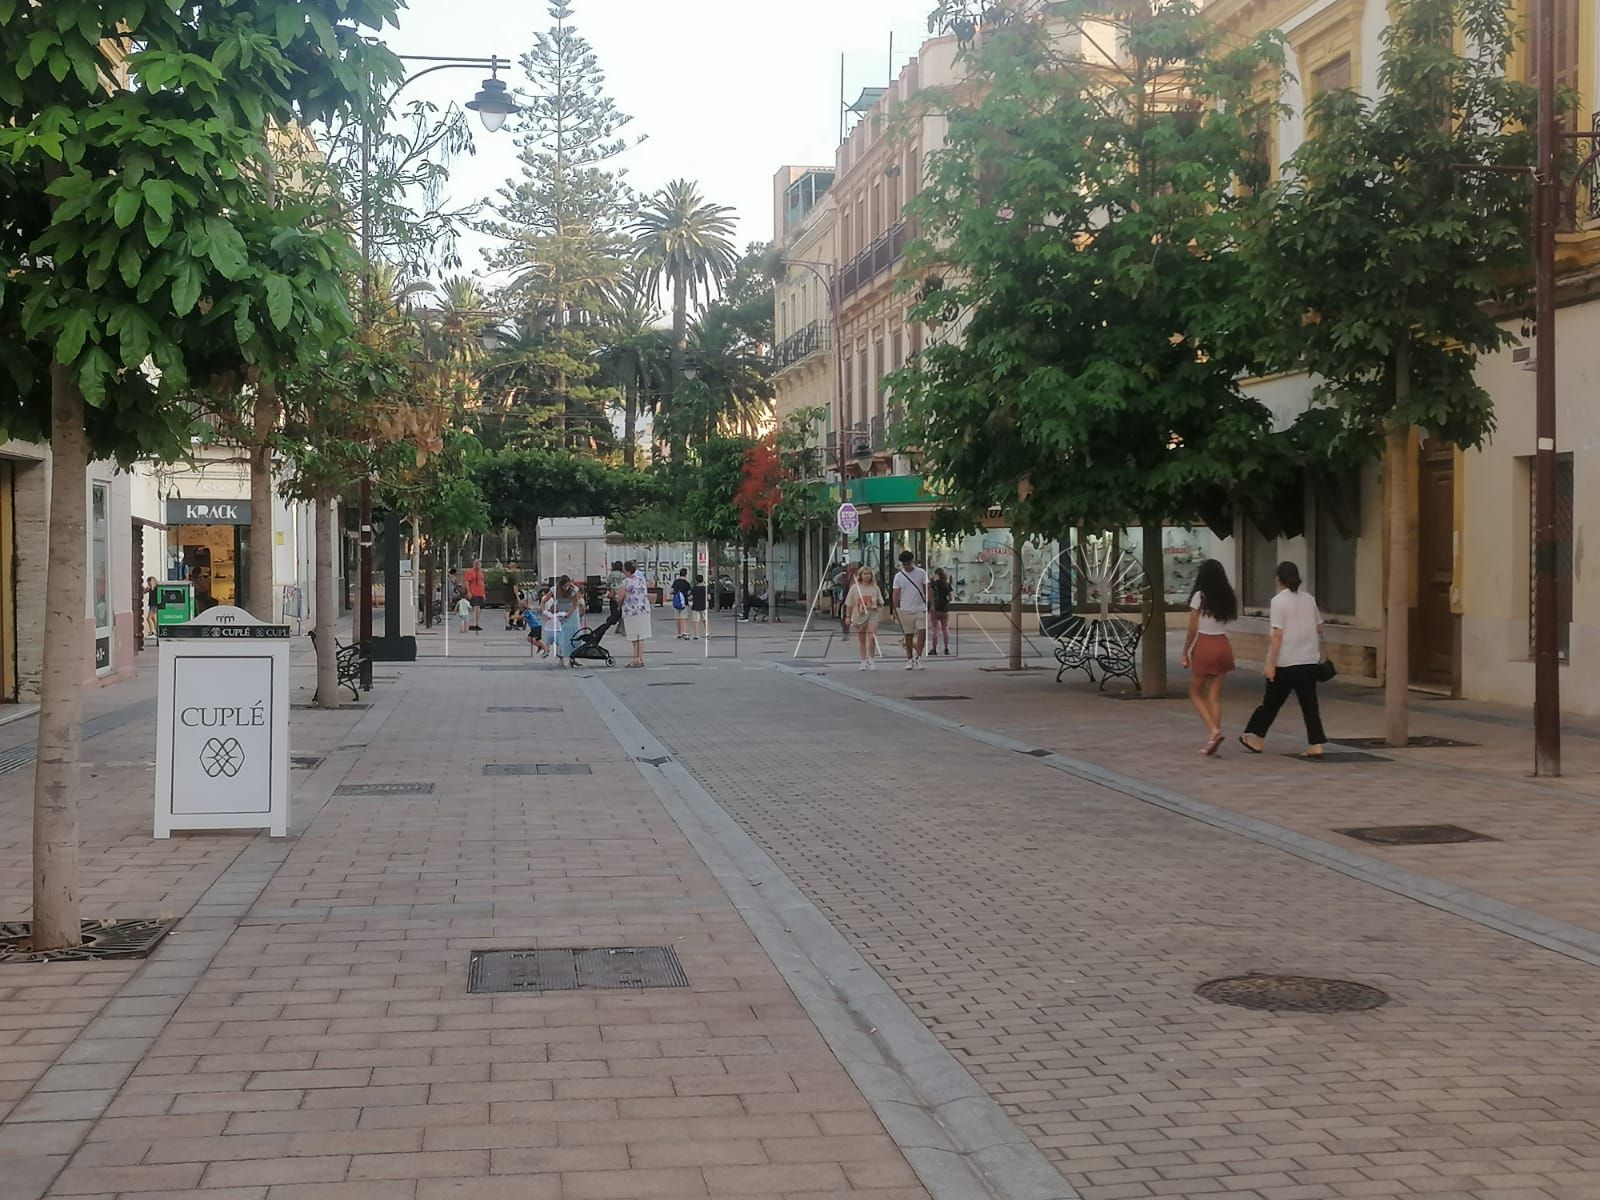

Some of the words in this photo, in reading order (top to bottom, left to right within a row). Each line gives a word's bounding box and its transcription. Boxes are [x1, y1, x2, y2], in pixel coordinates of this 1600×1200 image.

[186, 504, 239, 519] KRACK
[841, 511, 856, 519] STOP
[222, 627, 250, 637] CUPLÉ
[180, 699, 265, 727] CUPLÉ
